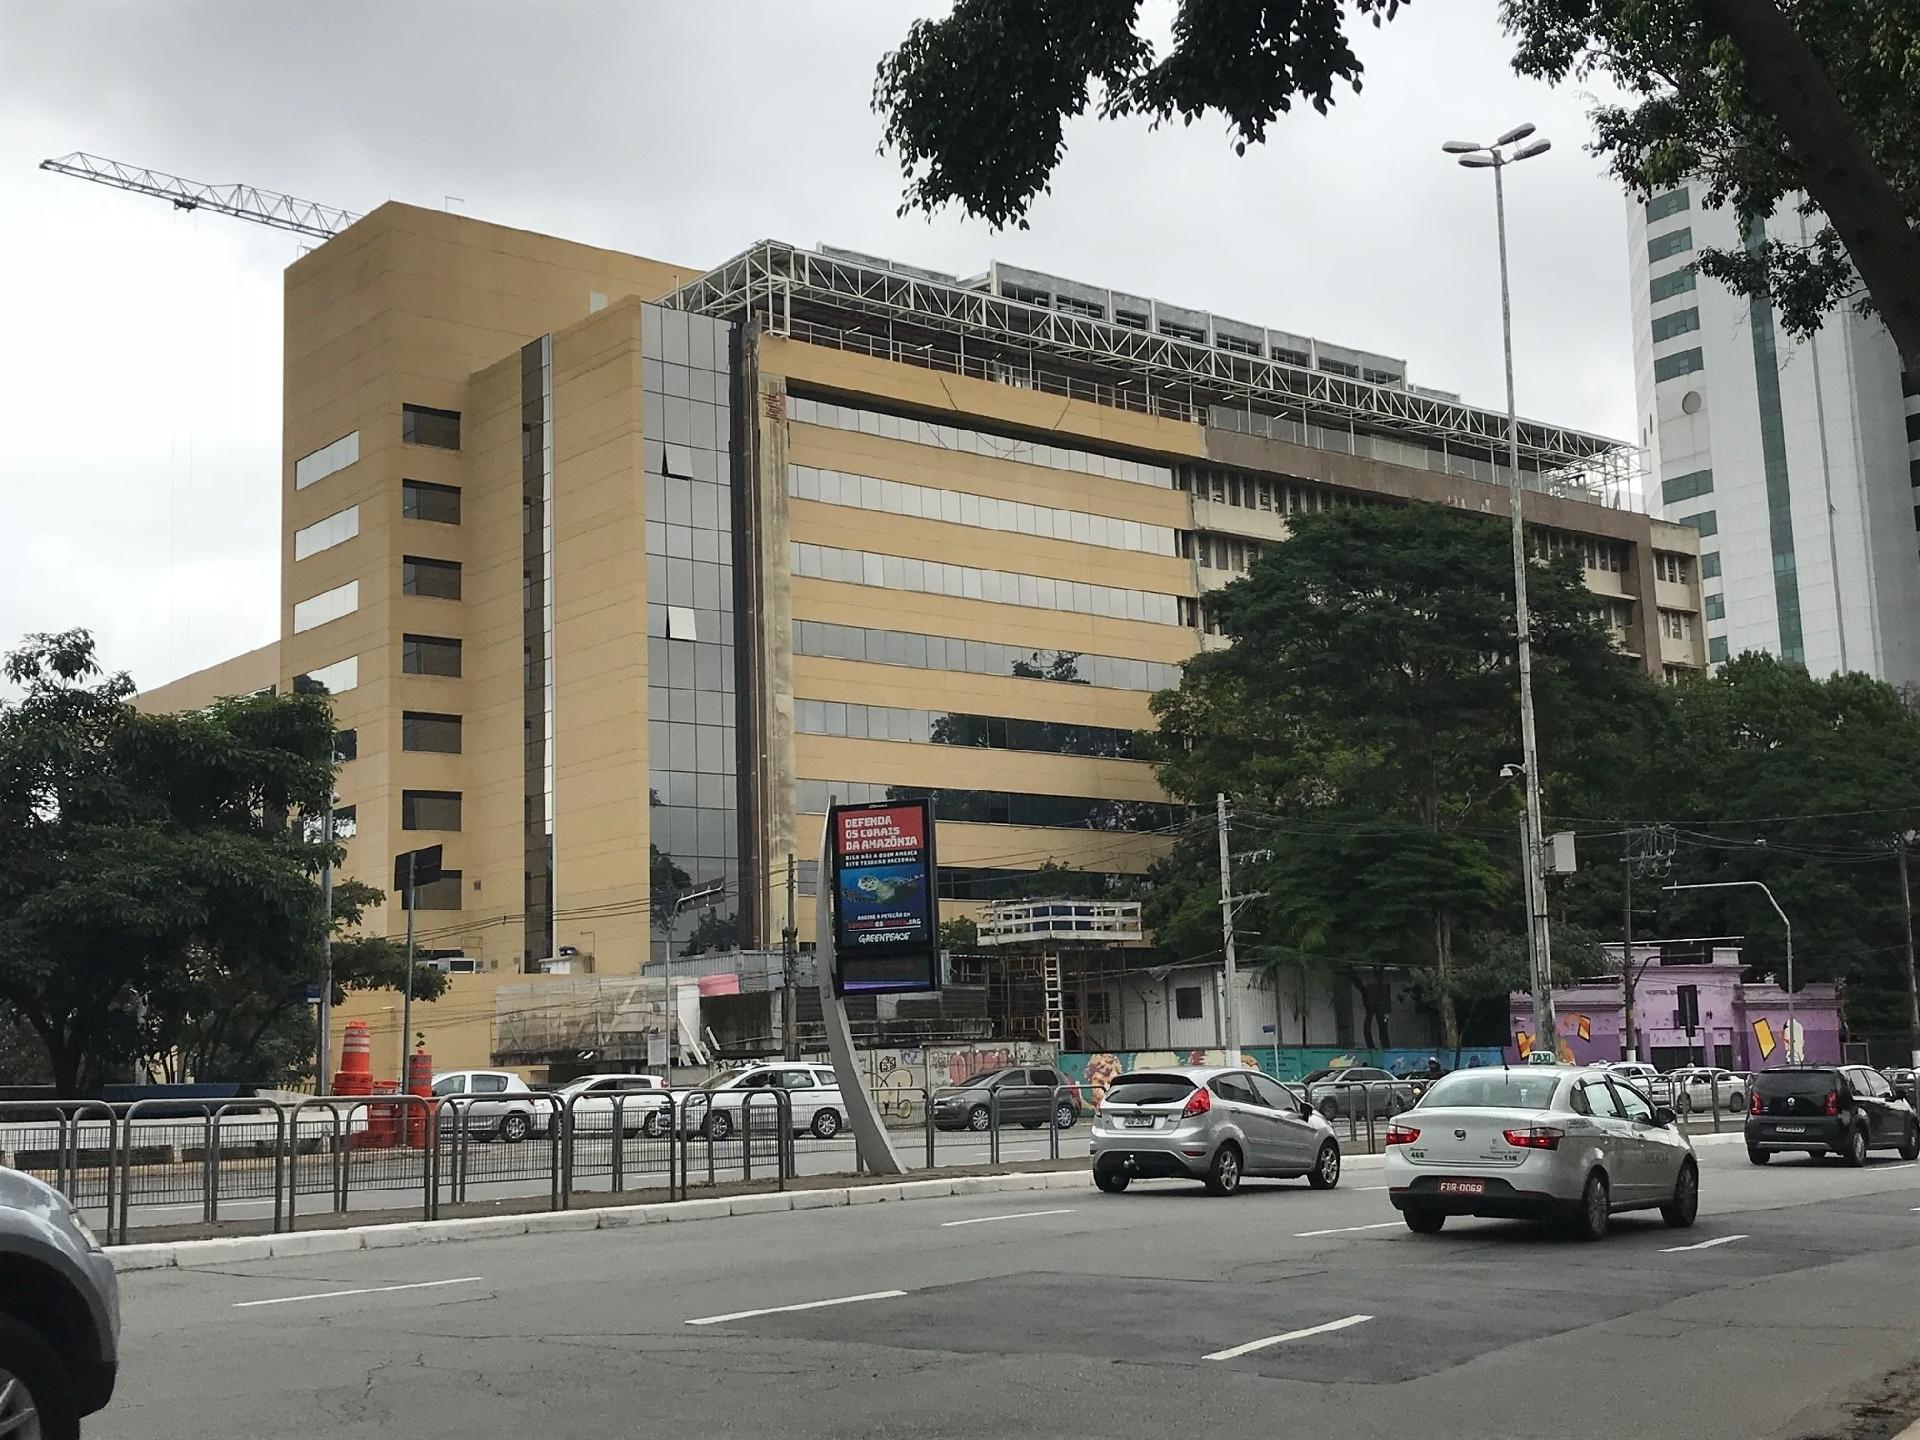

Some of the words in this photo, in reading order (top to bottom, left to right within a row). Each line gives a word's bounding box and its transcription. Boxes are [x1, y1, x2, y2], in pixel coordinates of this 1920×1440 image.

[844, 816, 892, 829] DEFENDA
[845, 829, 859, 839] OS
[860, 827, 900, 837] CORAIS
[845, 841, 860, 851] DA
[861, 836, 917, 850] AMAZÔNIA
[858, 932, 911, 944] GREENPEACE
[1531, 1053, 1551, 1062] TAXI
